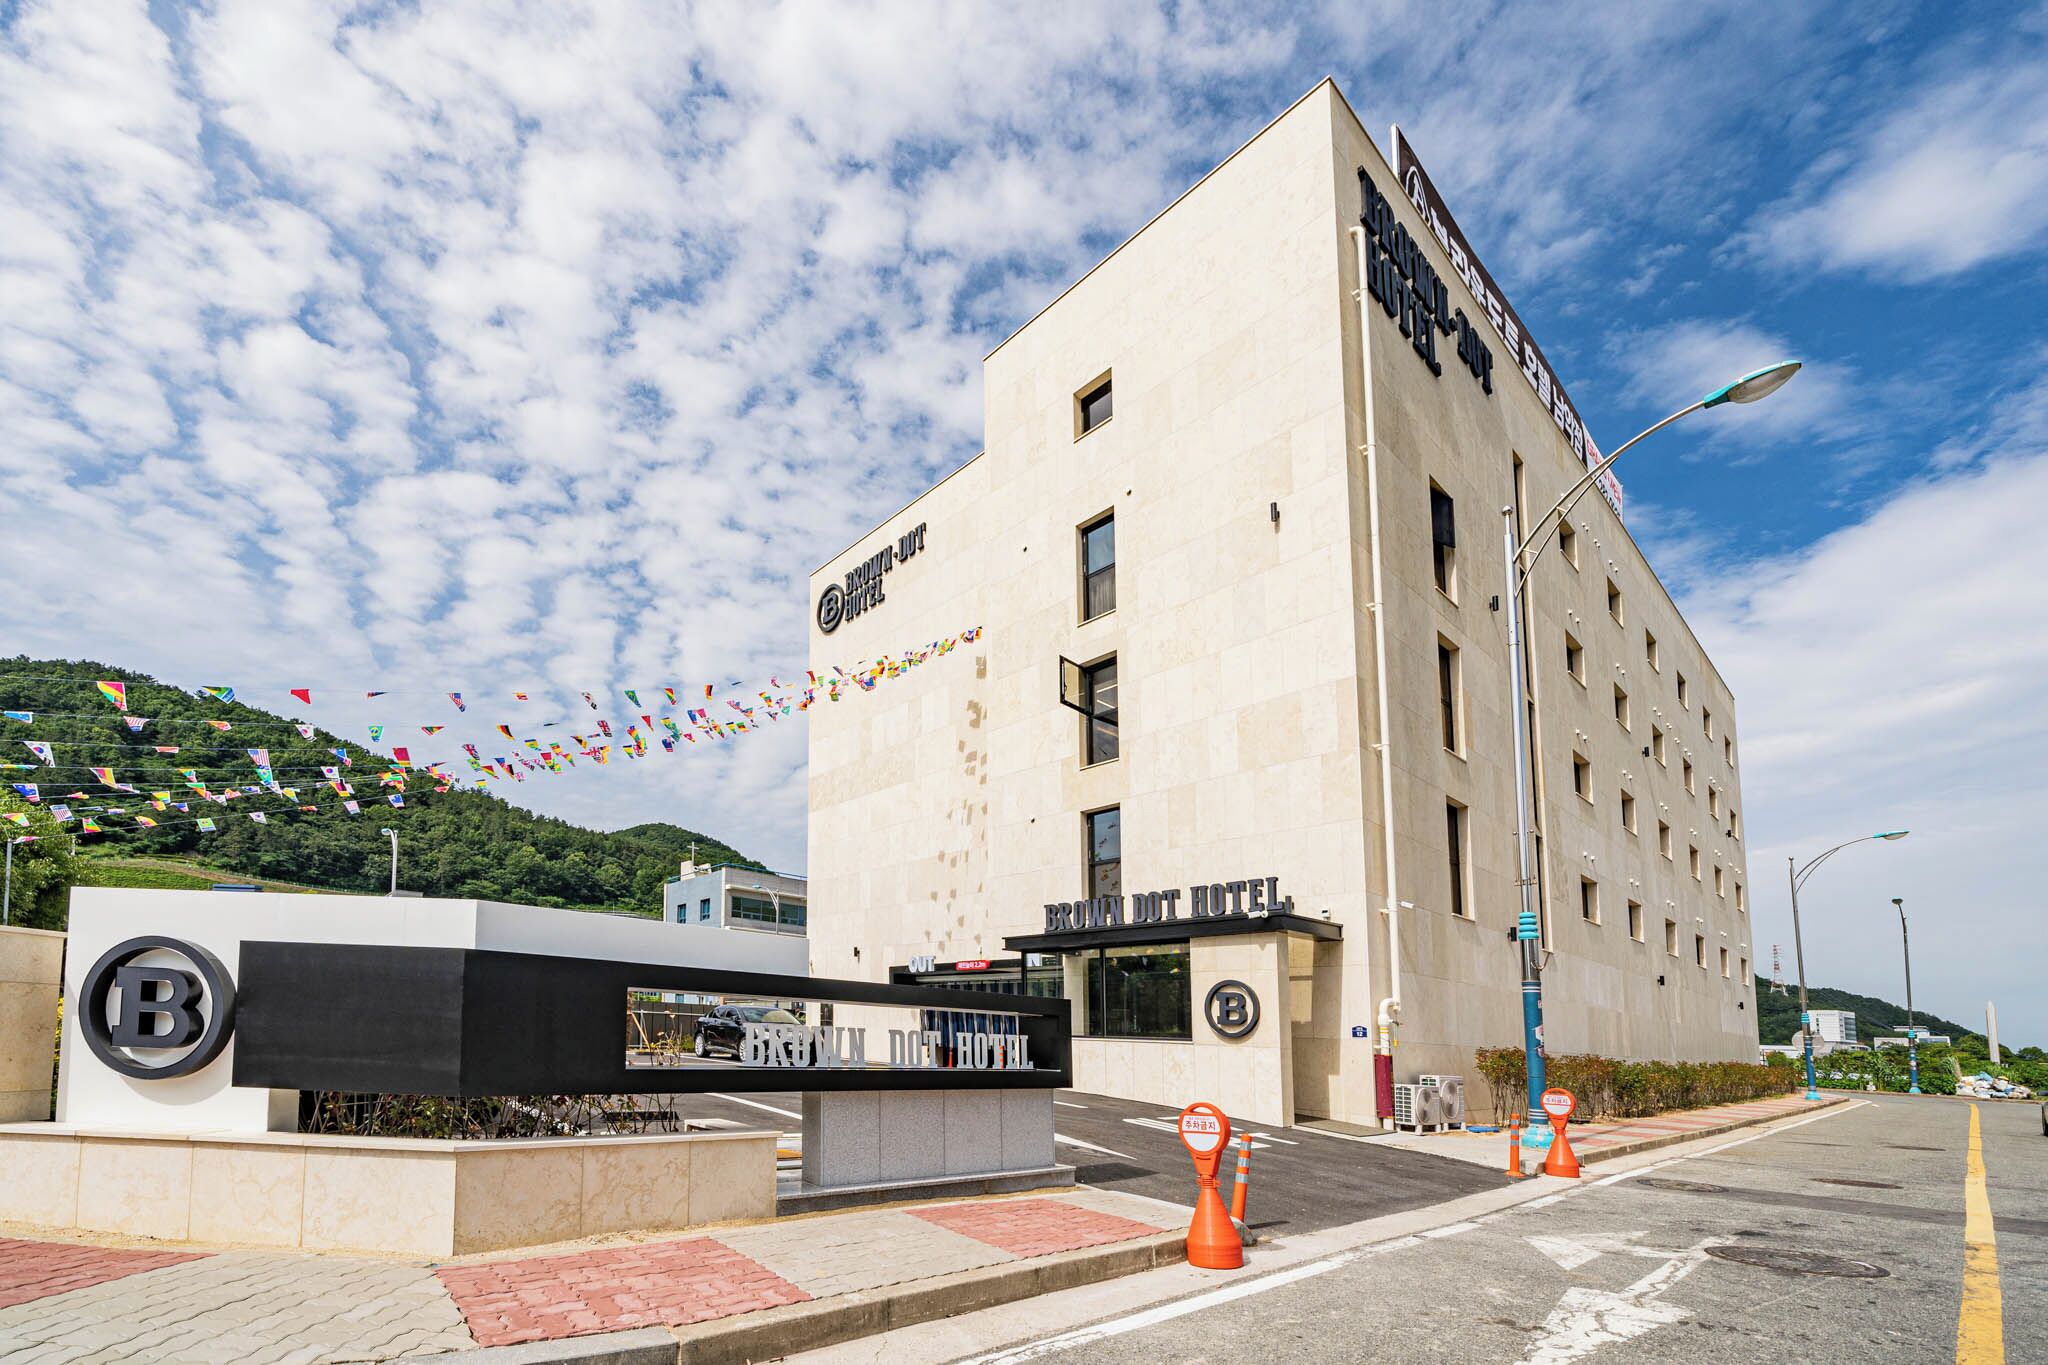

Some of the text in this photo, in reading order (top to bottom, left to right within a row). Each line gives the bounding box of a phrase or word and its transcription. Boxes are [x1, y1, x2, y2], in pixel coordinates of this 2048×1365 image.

[1365, 231, 1442, 378] HOTEL
[1523, 341, 1551, 410] 호텔
[844, 578, 885, 622] HOTEL
[1043, 876, 1285, 932] BROWN DOT HOTEL
[908, 955, 936, 973] OUT
[744, 1023, 1034, 1069] BROWN DOT HOTEL
[1185, 1120, 1216, 1131] 주차금지
